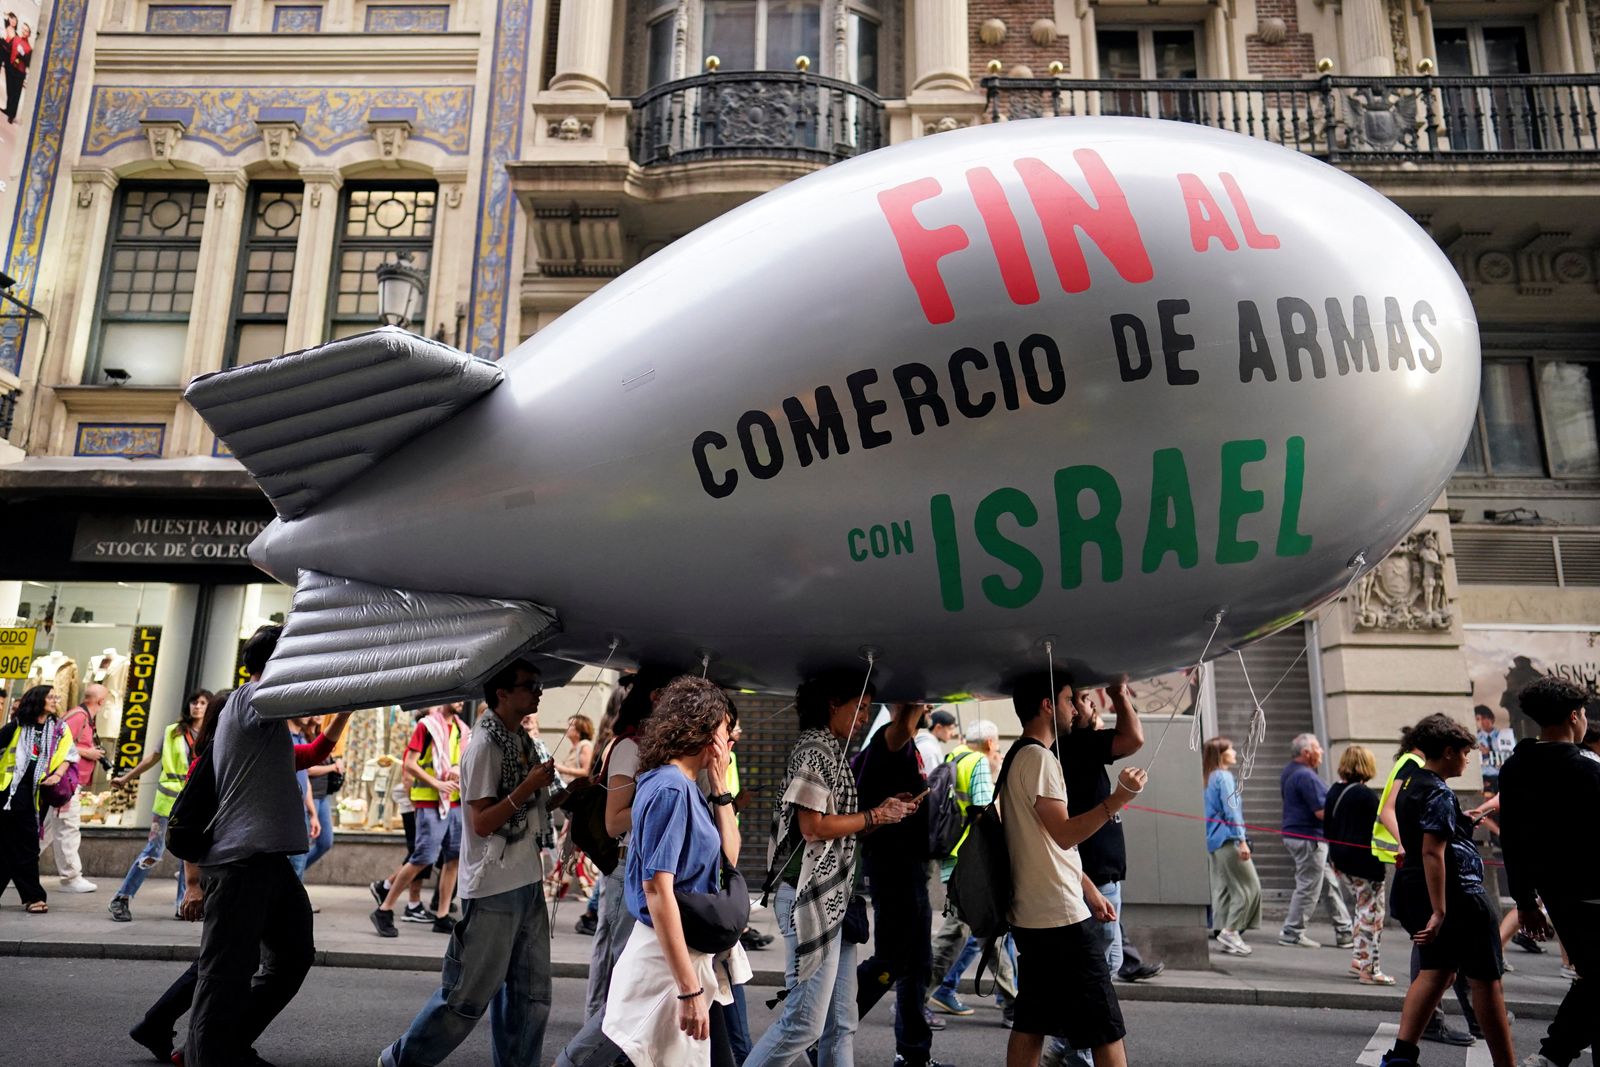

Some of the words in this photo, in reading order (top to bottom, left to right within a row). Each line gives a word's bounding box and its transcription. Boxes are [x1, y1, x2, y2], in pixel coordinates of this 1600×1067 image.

[877, 148, 1155, 326] FIN
[1177, 171, 1281, 253] AL
[691, 332, 1068, 500] COMERCIO
[1109, 298, 1201, 387] DE
[1237, 294, 1443, 384] ARMAS
[95, 541, 157, 557] STOCK
[163, 542, 186, 557] DE
[847, 519, 915, 563] CON
[929, 434, 1314, 613] ISRAEL
[0, 630, 28, 644] ODO
[119, 628, 156, 768] LIQUIDACION
